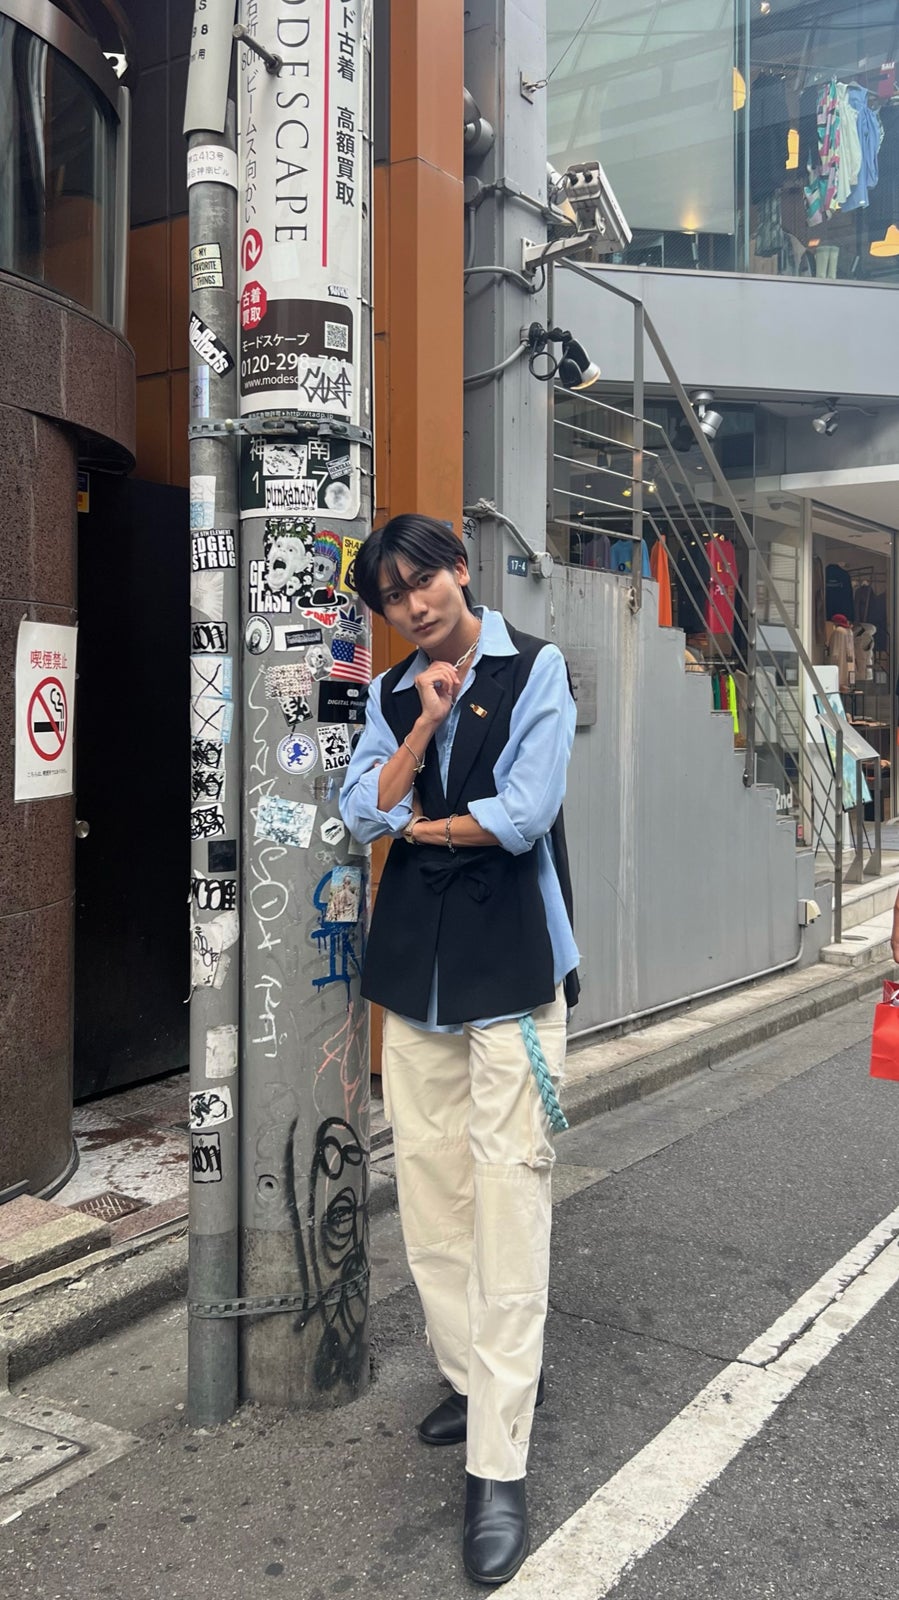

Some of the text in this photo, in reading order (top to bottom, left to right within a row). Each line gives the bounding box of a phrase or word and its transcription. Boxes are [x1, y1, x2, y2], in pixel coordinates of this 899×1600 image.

[275, 0, 310, 243] DESCAPE
[193, 261, 217, 272] FAVORITE
[196, 275, 216, 286] THINGS
[242, 286, 261, 308] 古着
[242, 307, 261, 327] 買取
[243, 332, 311, 352] モードスケープ
[192, 535, 235, 555] EDGER
[192, 551, 236, 571] STRUG
[511, 560, 526, 572] 17-4
[30, 650, 68, 670] 喫煙禁止
[776, 787, 793, 811] 2nd
